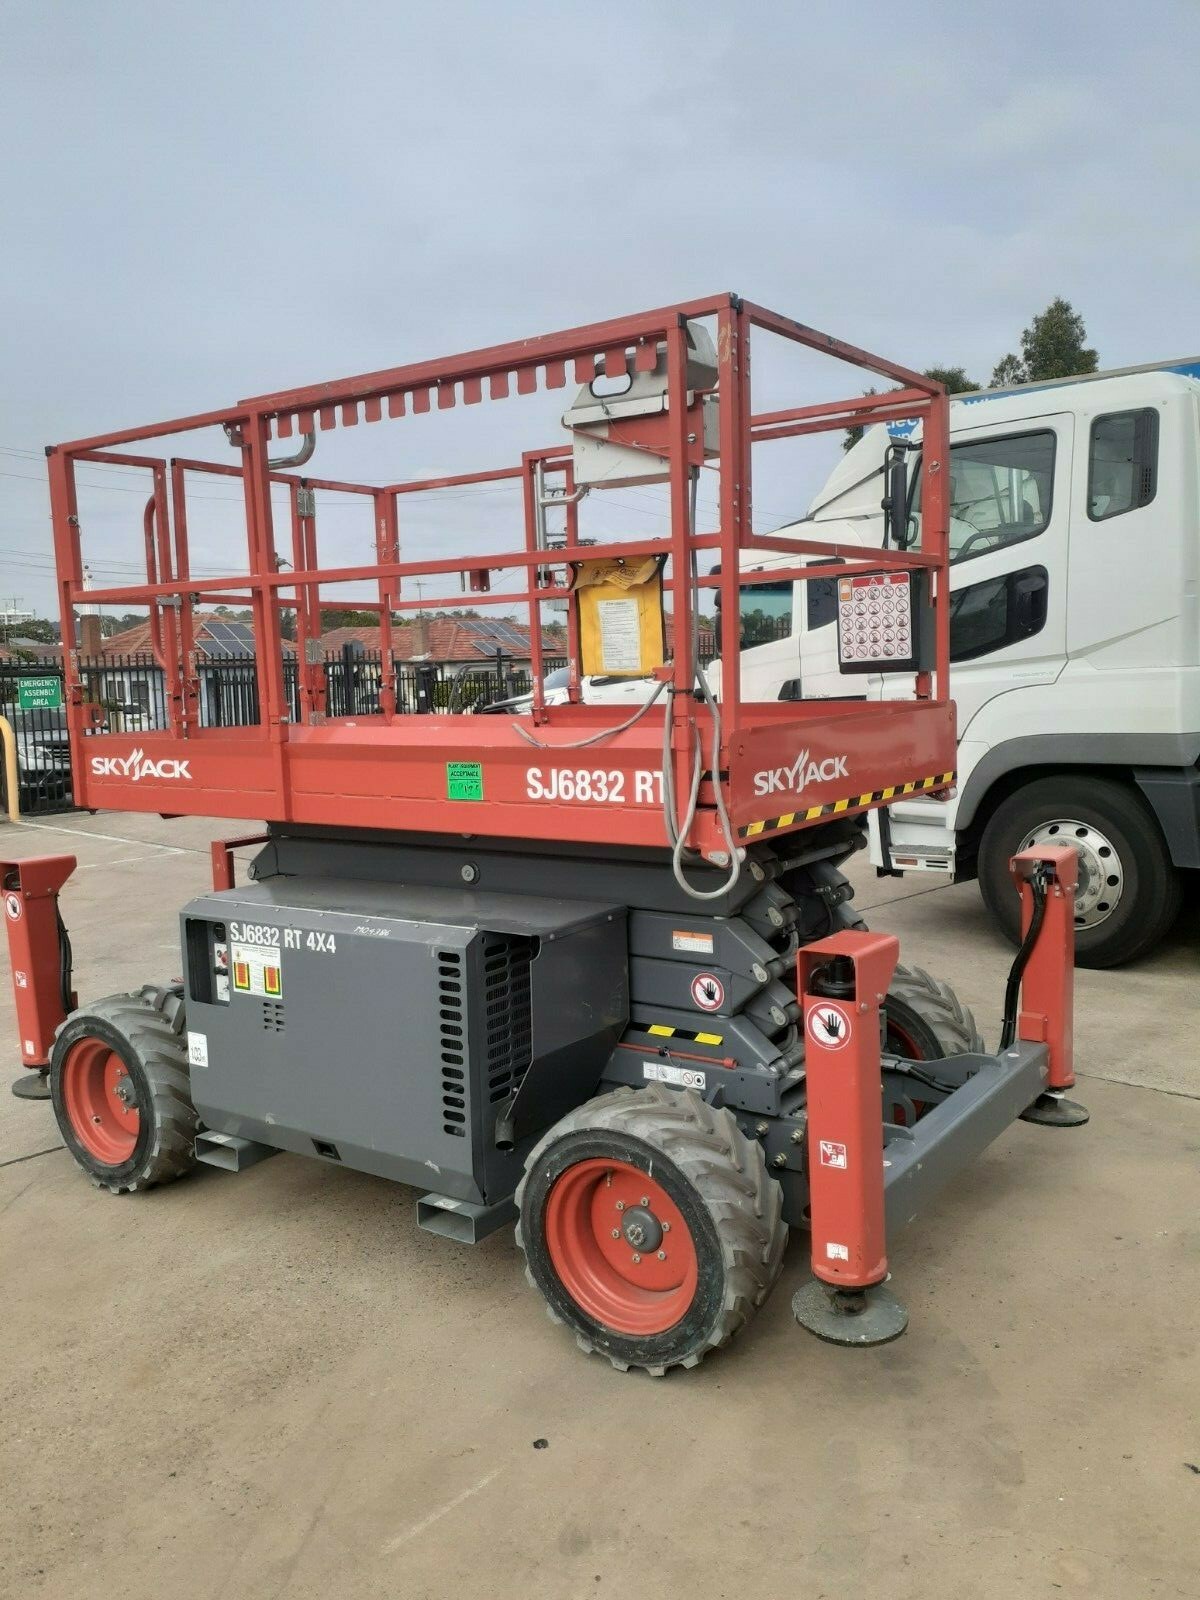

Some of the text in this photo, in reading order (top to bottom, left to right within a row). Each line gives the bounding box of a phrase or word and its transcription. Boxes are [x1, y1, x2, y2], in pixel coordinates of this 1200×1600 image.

[20, 679, 58, 688] EMERGENCY
[24, 689, 55, 697] ASSEMBLY
[32, 698, 49, 706] AREA
[91, 748, 192, 781] SKYJACK
[753, 748, 850, 796] SKYJACK
[526, 767, 626, 802] SJ6832
[230, 921, 281, 947] SJ6832
[284, 928, 303, 950] RT
[306, 931, 337, 954] 4X4
